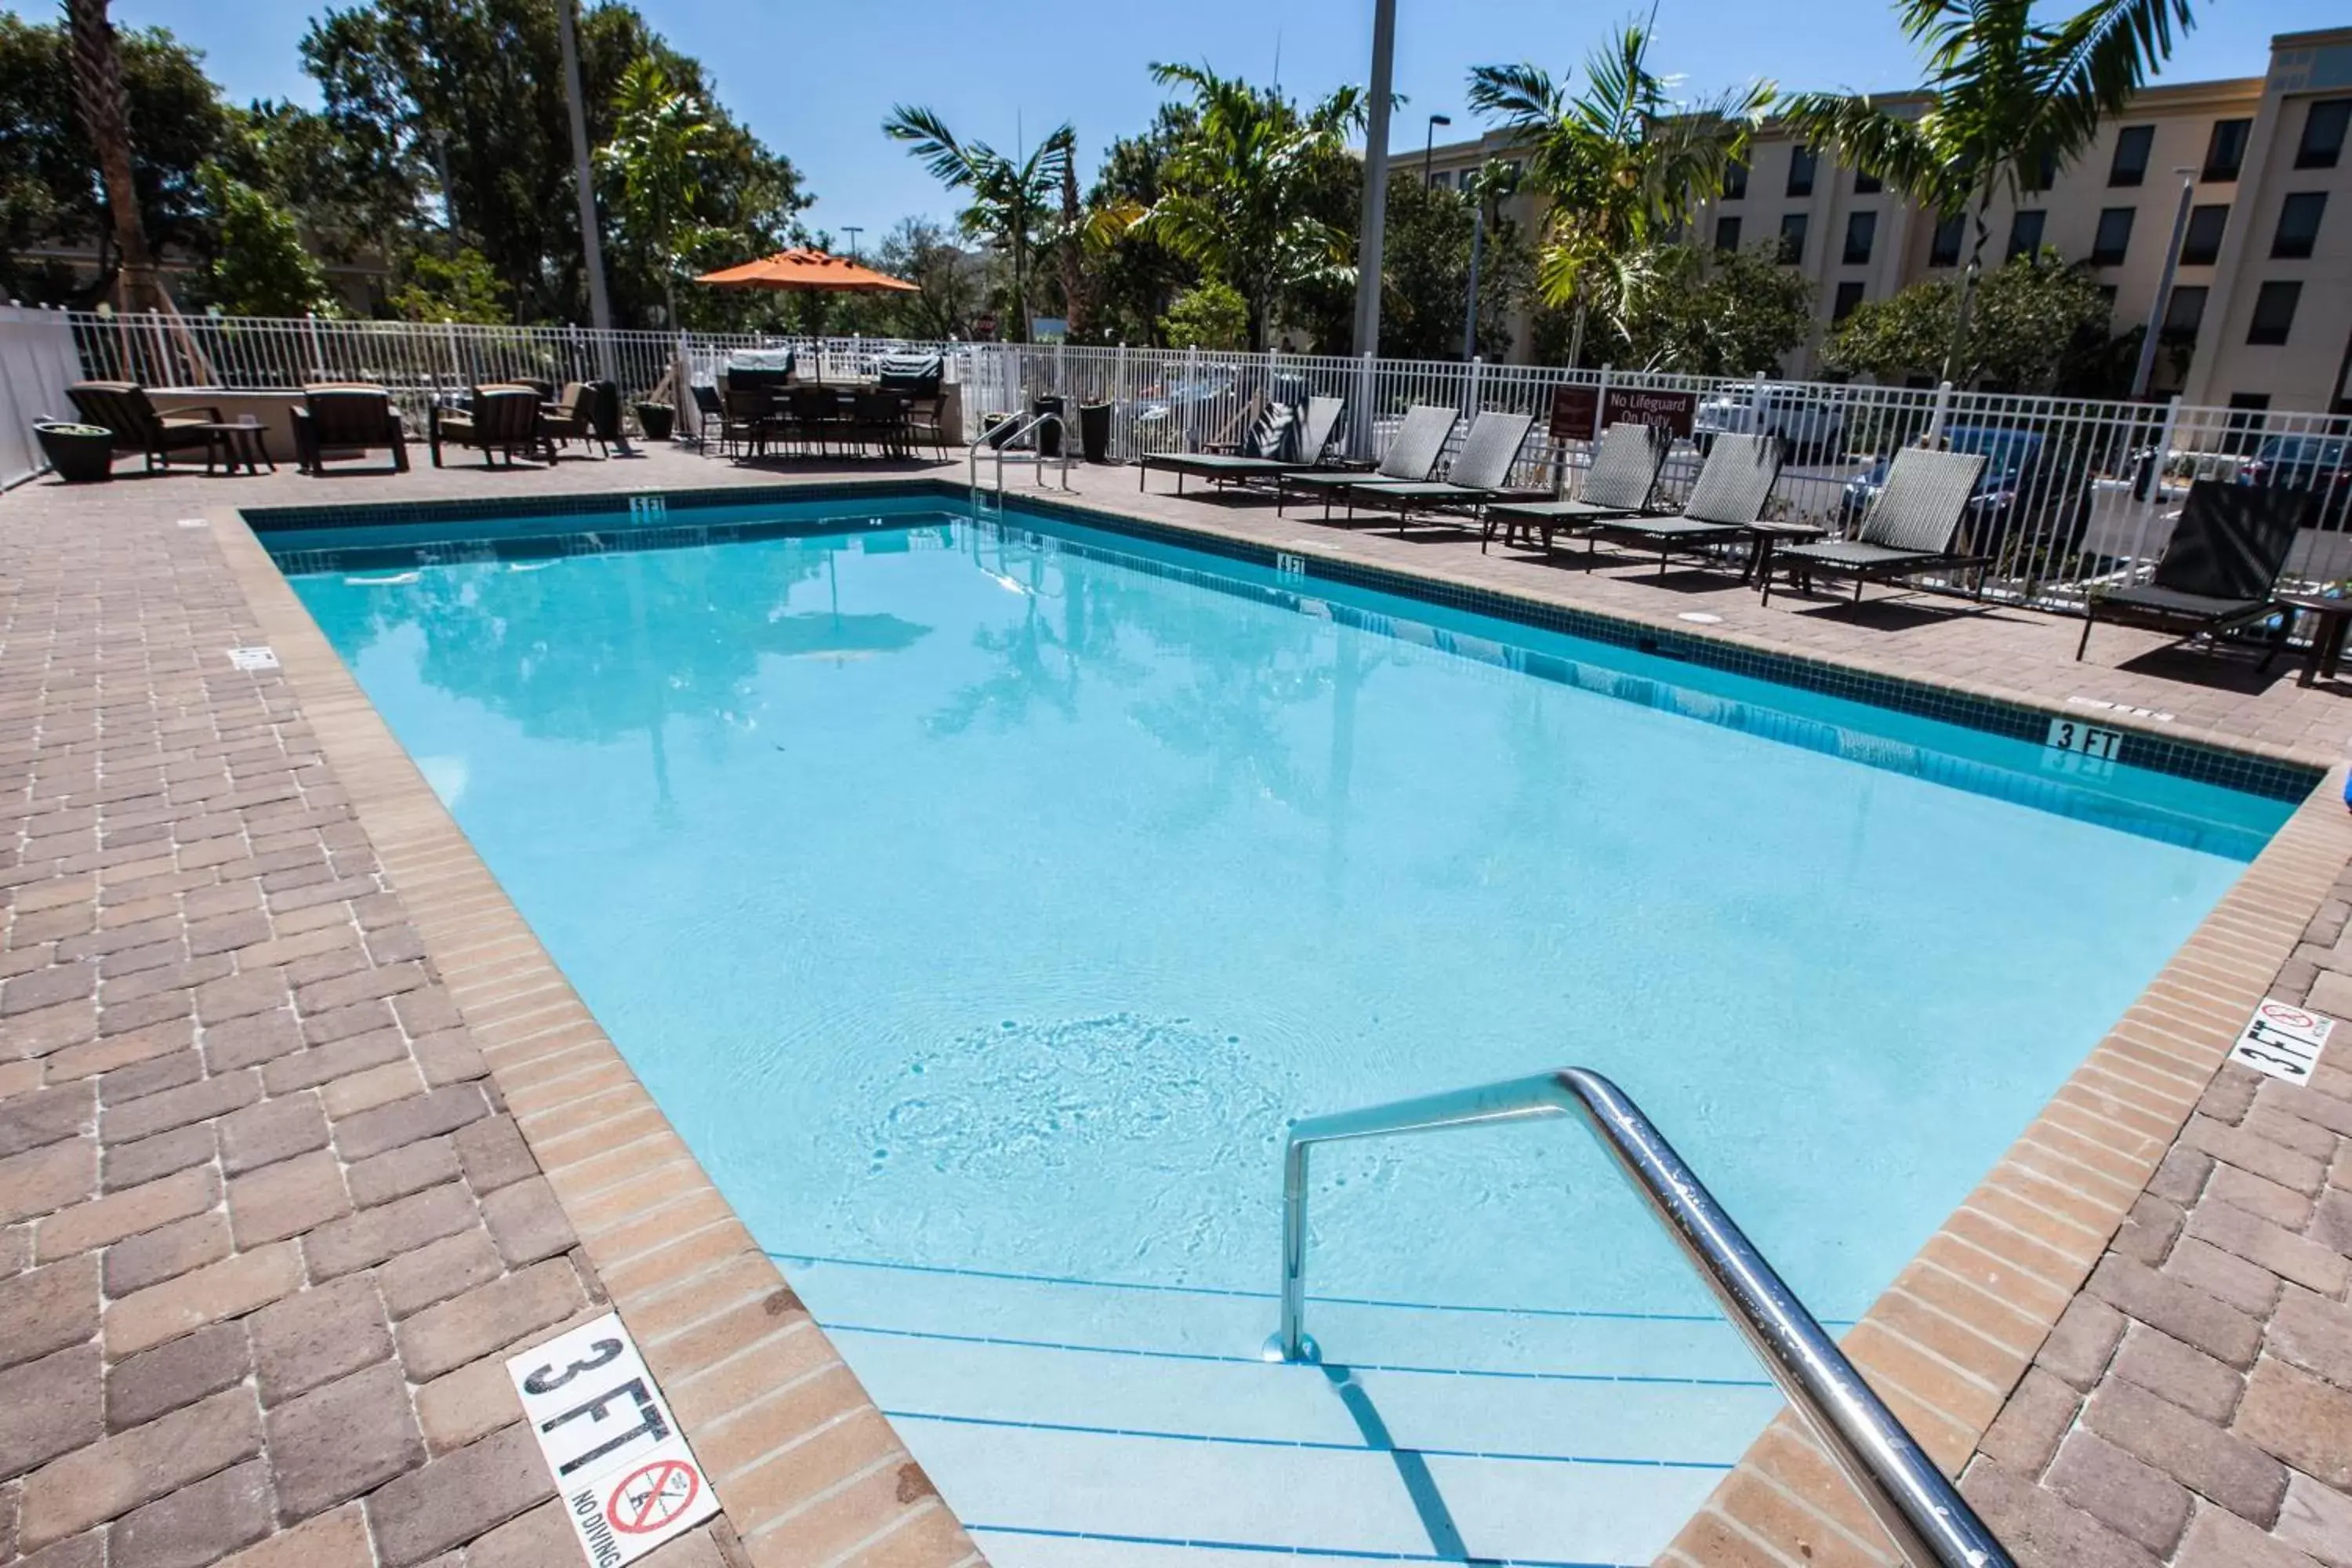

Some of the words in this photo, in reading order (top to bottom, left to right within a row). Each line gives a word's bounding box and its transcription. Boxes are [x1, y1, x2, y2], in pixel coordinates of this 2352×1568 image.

[1611, 393, 1626, 407] No
[1630, 394, 1686, 412] Lifeguard
[1621, 410, 1638, 423] On
[1642, 412, 1671, 428] Duty
[1291, 557, 1304, 573] FT
[2057, 724, 2074, 749] 3
[2082, 728, 2119, 758] FT
[2248, 1020, 2318, 1060] FT
[2239, 1047, 2307, 1074] 3
[523, 1338, 624, 1395] 3
[541, 1377, 671, 1476] FT
[572, 1489, 598, 1515] NO
[582, 1512, 621, 1568] DIVING
